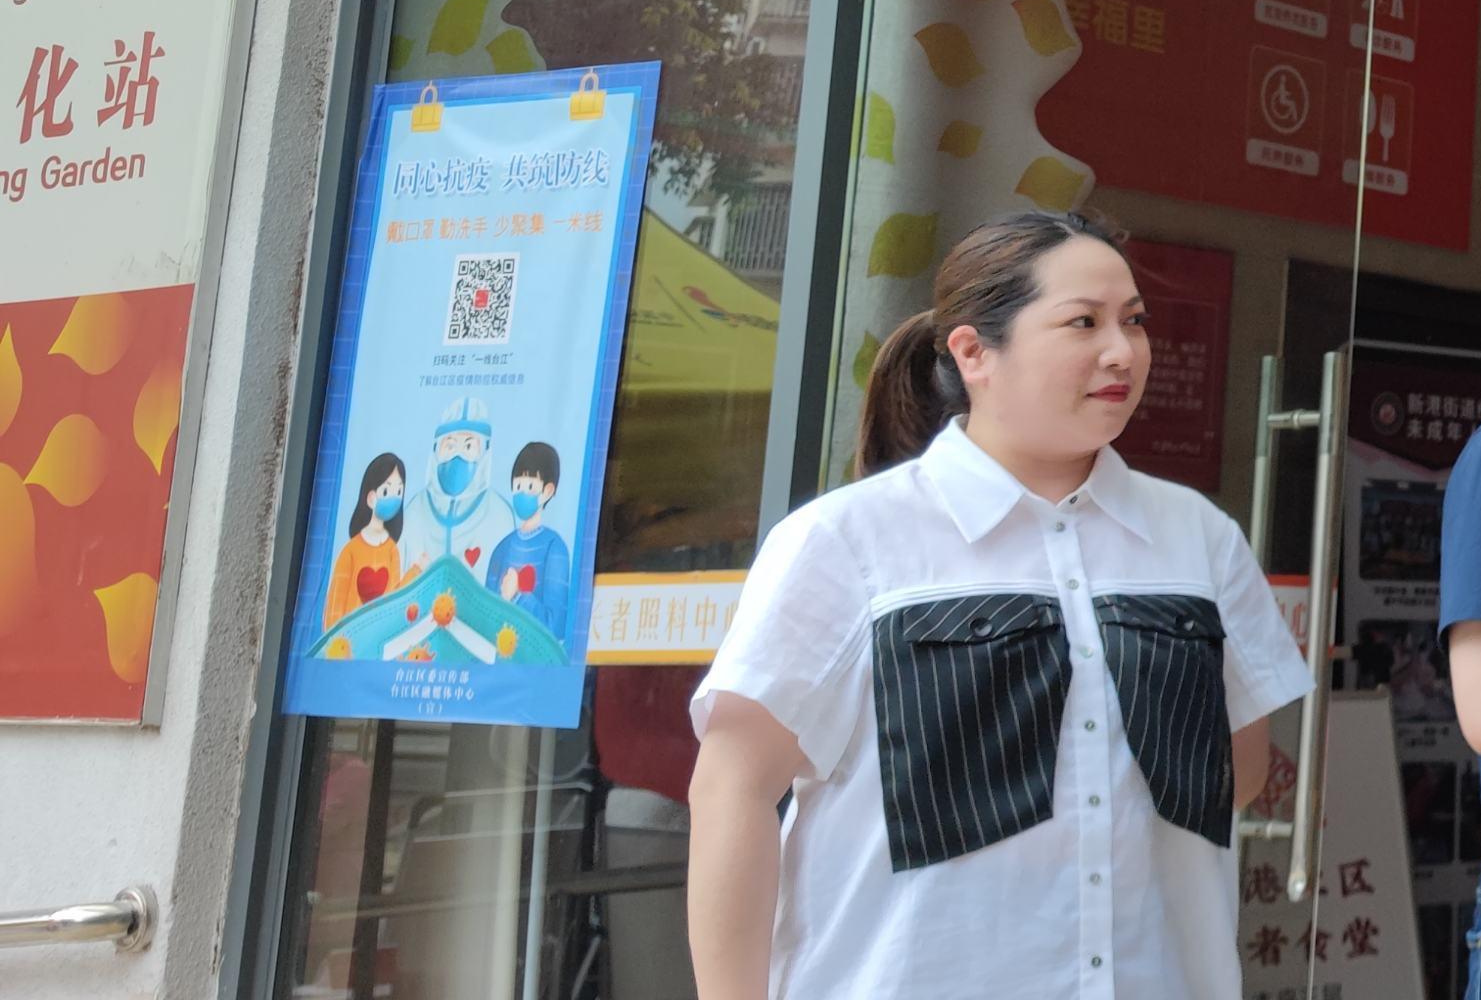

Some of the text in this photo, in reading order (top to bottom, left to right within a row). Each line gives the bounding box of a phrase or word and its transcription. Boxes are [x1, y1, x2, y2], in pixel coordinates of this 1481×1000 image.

[16, 31, 166, 144] 化站
[41, 147, 146, 190] Garden
[393, 149, 609, 195] 同心抗疫 共筑防线
[493, 212, 545, 238] 少聚集
[553, 210, 604, 233] 一米线
